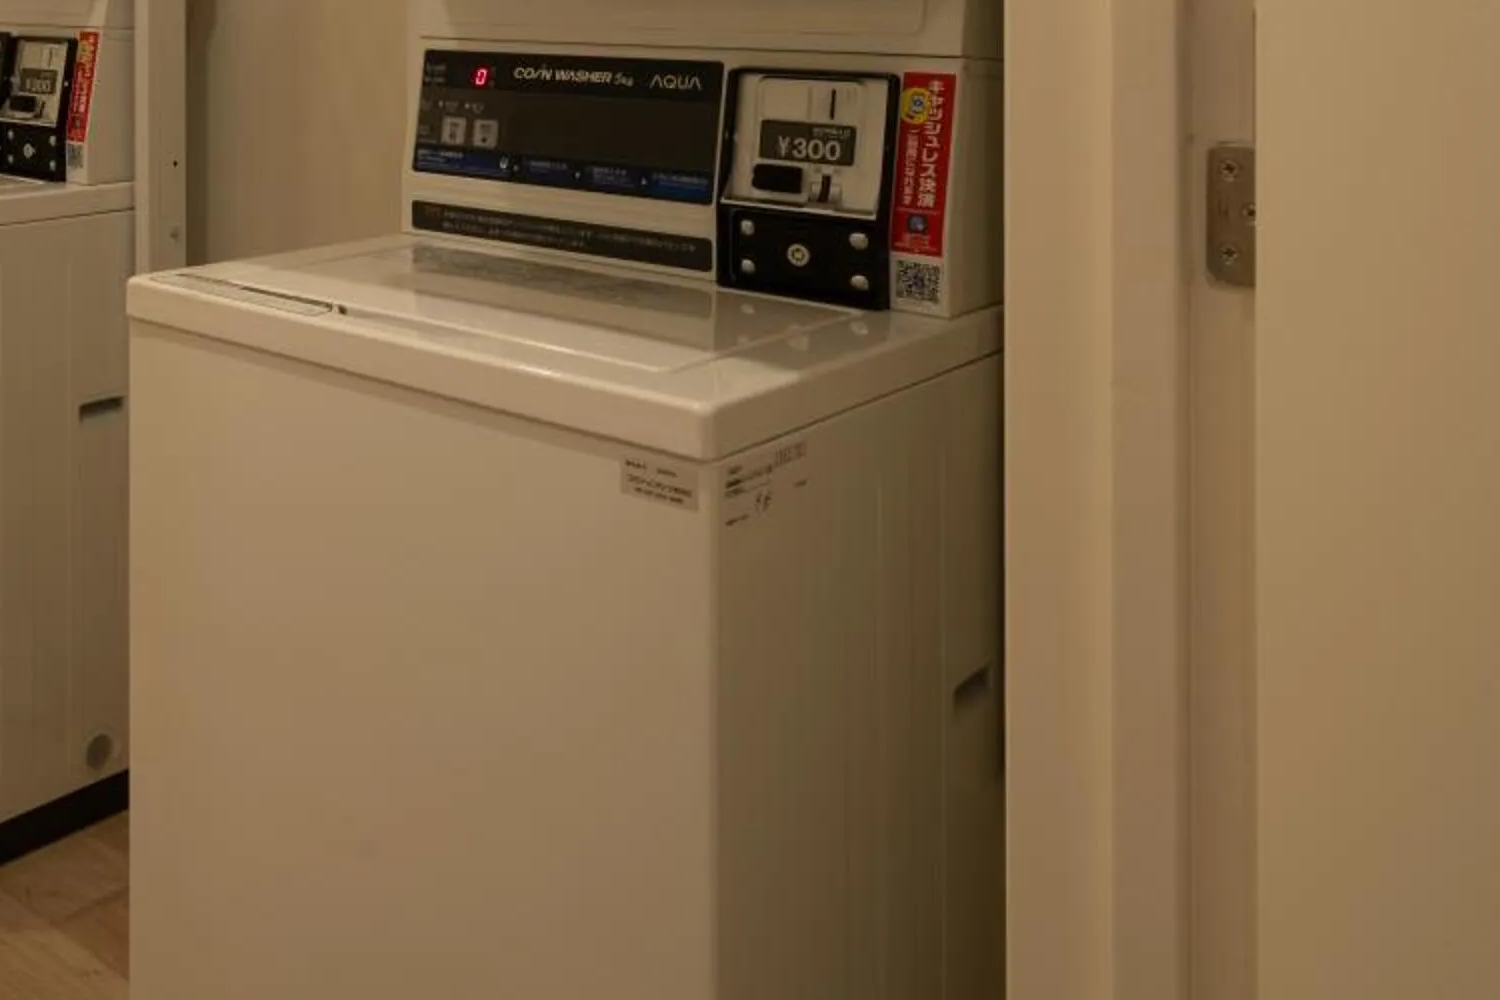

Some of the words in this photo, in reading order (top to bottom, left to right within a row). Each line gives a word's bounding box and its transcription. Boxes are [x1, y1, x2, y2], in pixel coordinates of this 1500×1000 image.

[555, 70, 612, 84] WASHER
[650, 74, 701, 91] AQUA
[778, 135, 841, 161] ¥300
